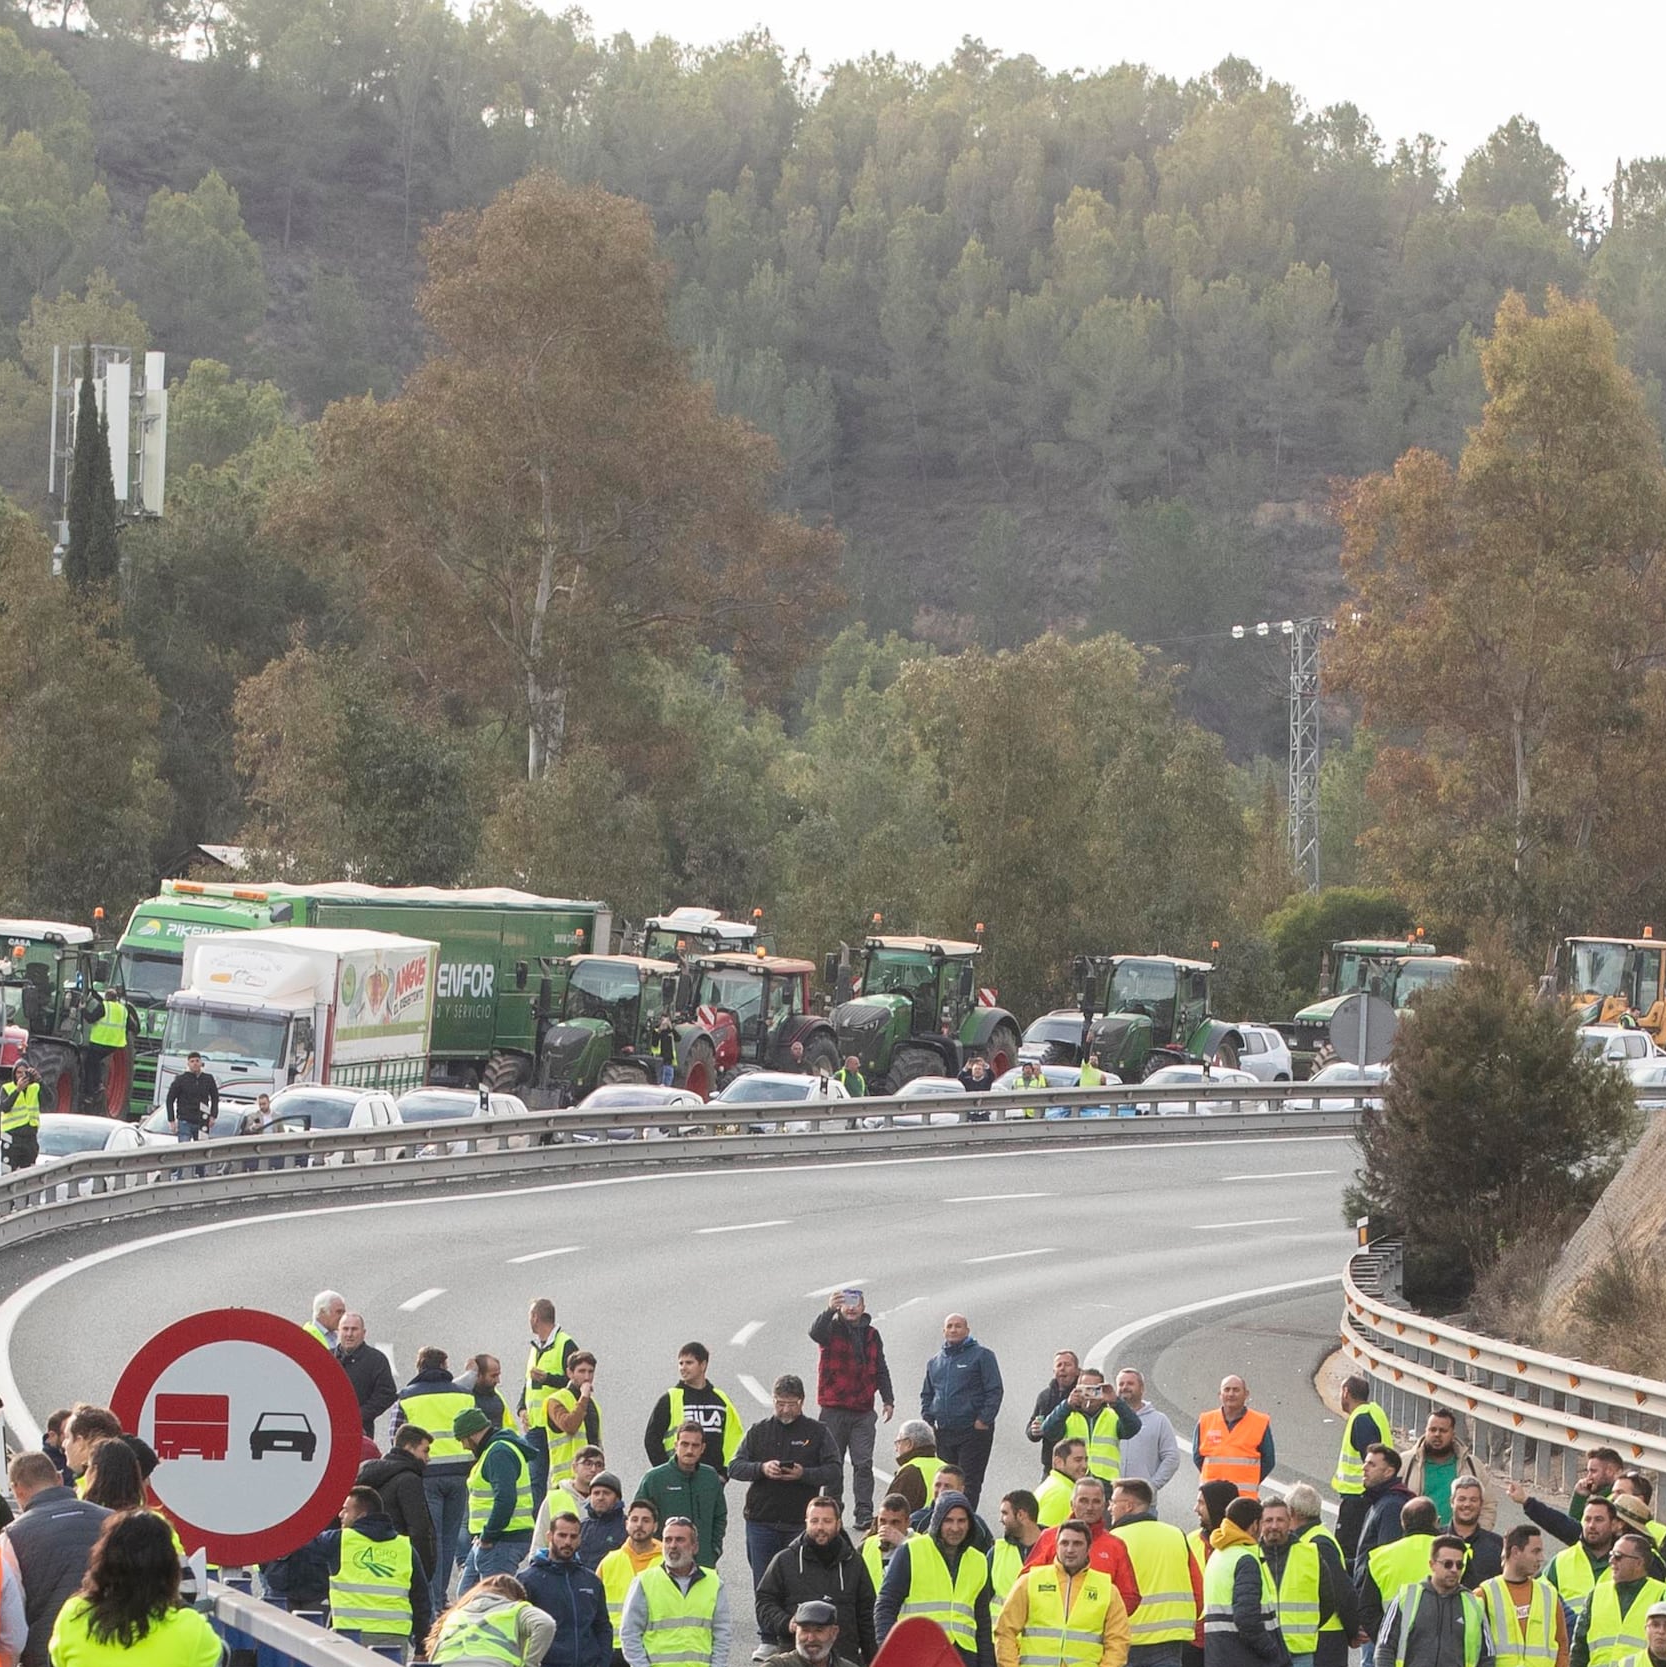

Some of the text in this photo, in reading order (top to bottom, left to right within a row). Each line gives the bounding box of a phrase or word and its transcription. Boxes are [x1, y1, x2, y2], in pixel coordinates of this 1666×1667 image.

[395, 957, 426, 1001] ANGUS
[437, 963, 495, 998] ENFOR
[454, 1004, 492, 1019] SERVICIO
